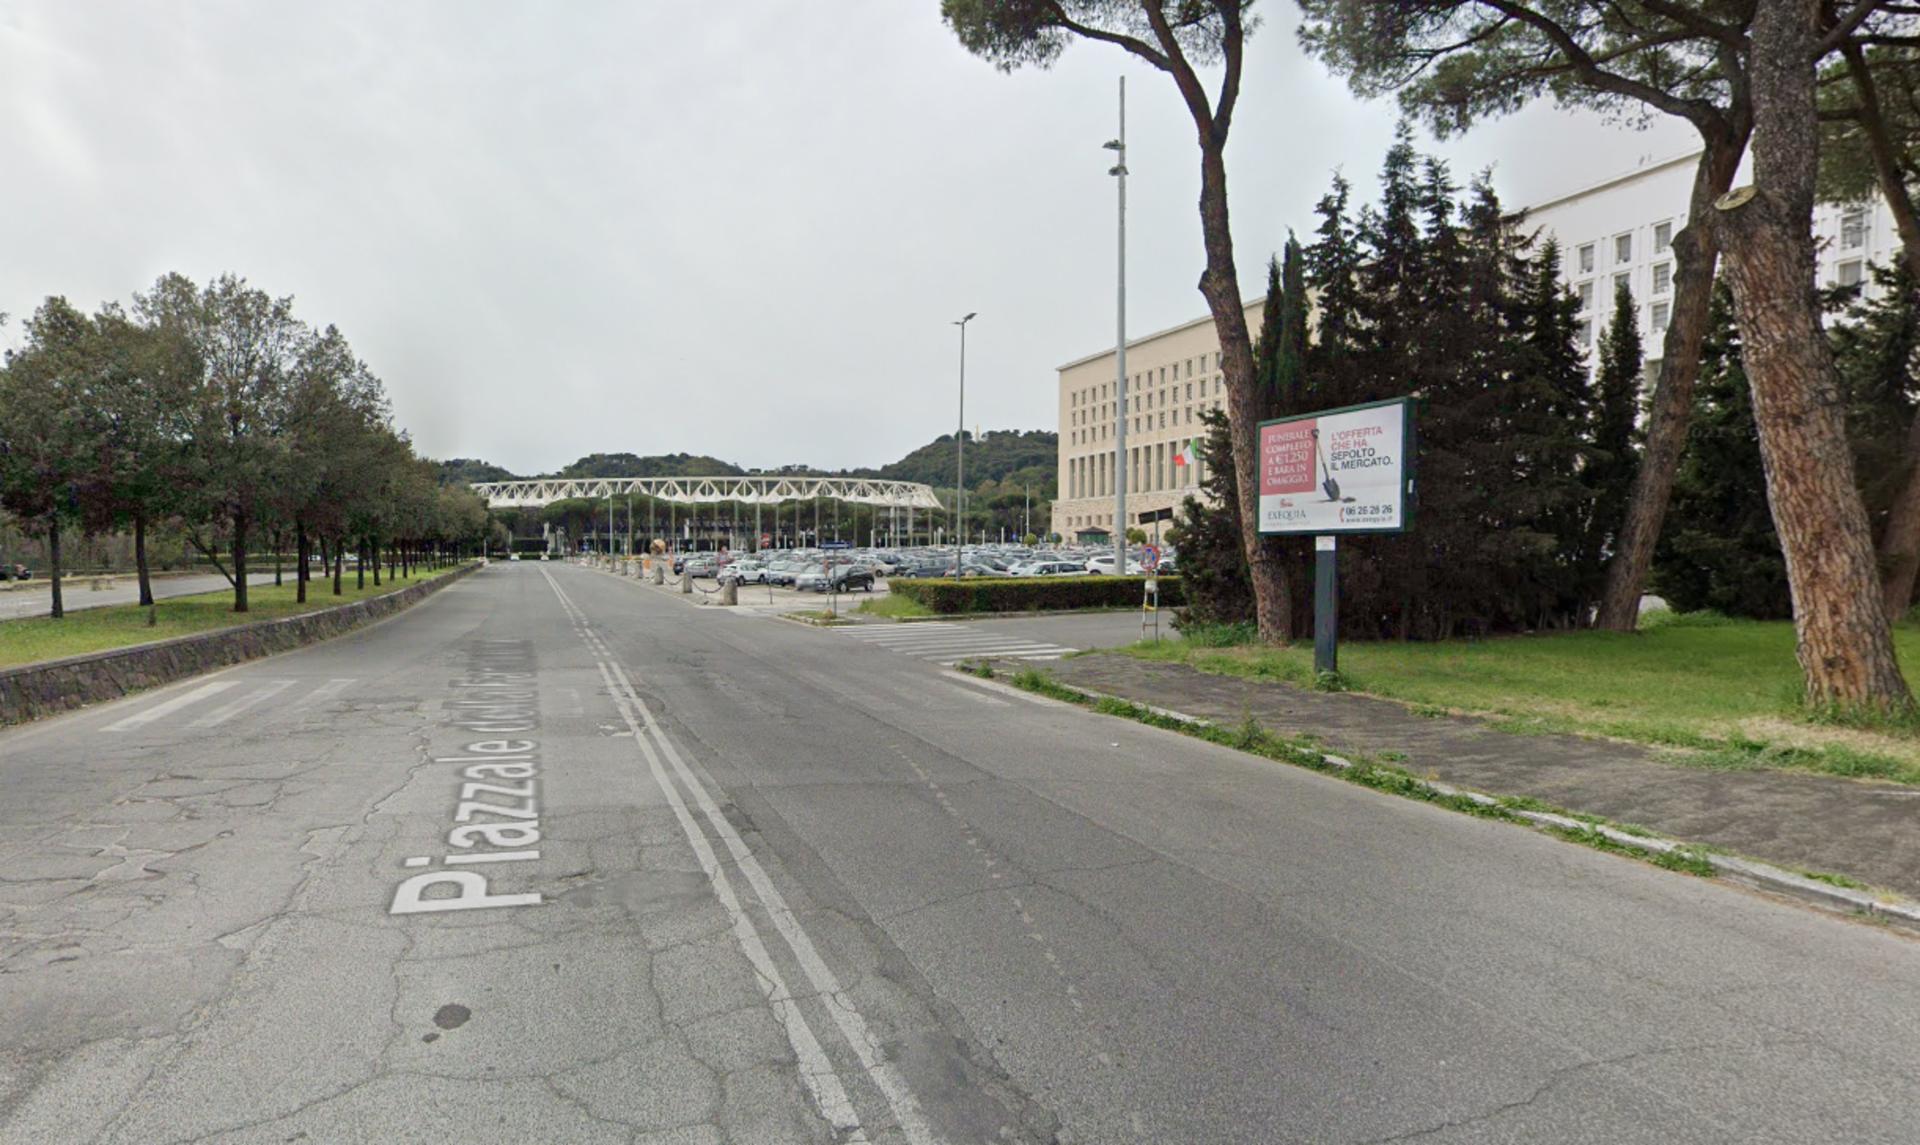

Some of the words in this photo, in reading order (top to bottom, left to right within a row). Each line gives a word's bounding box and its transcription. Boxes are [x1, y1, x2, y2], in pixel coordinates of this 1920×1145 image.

[1331, 426, 1383, 441] L'OFFERTA
[1331, 440, 1351, 451] CHE
[1353, 438, 1367, 449] HA
[1331, 447, 1375, 462] SEPOLTO
[1341, 455, 1393, 470] MERCATO.
